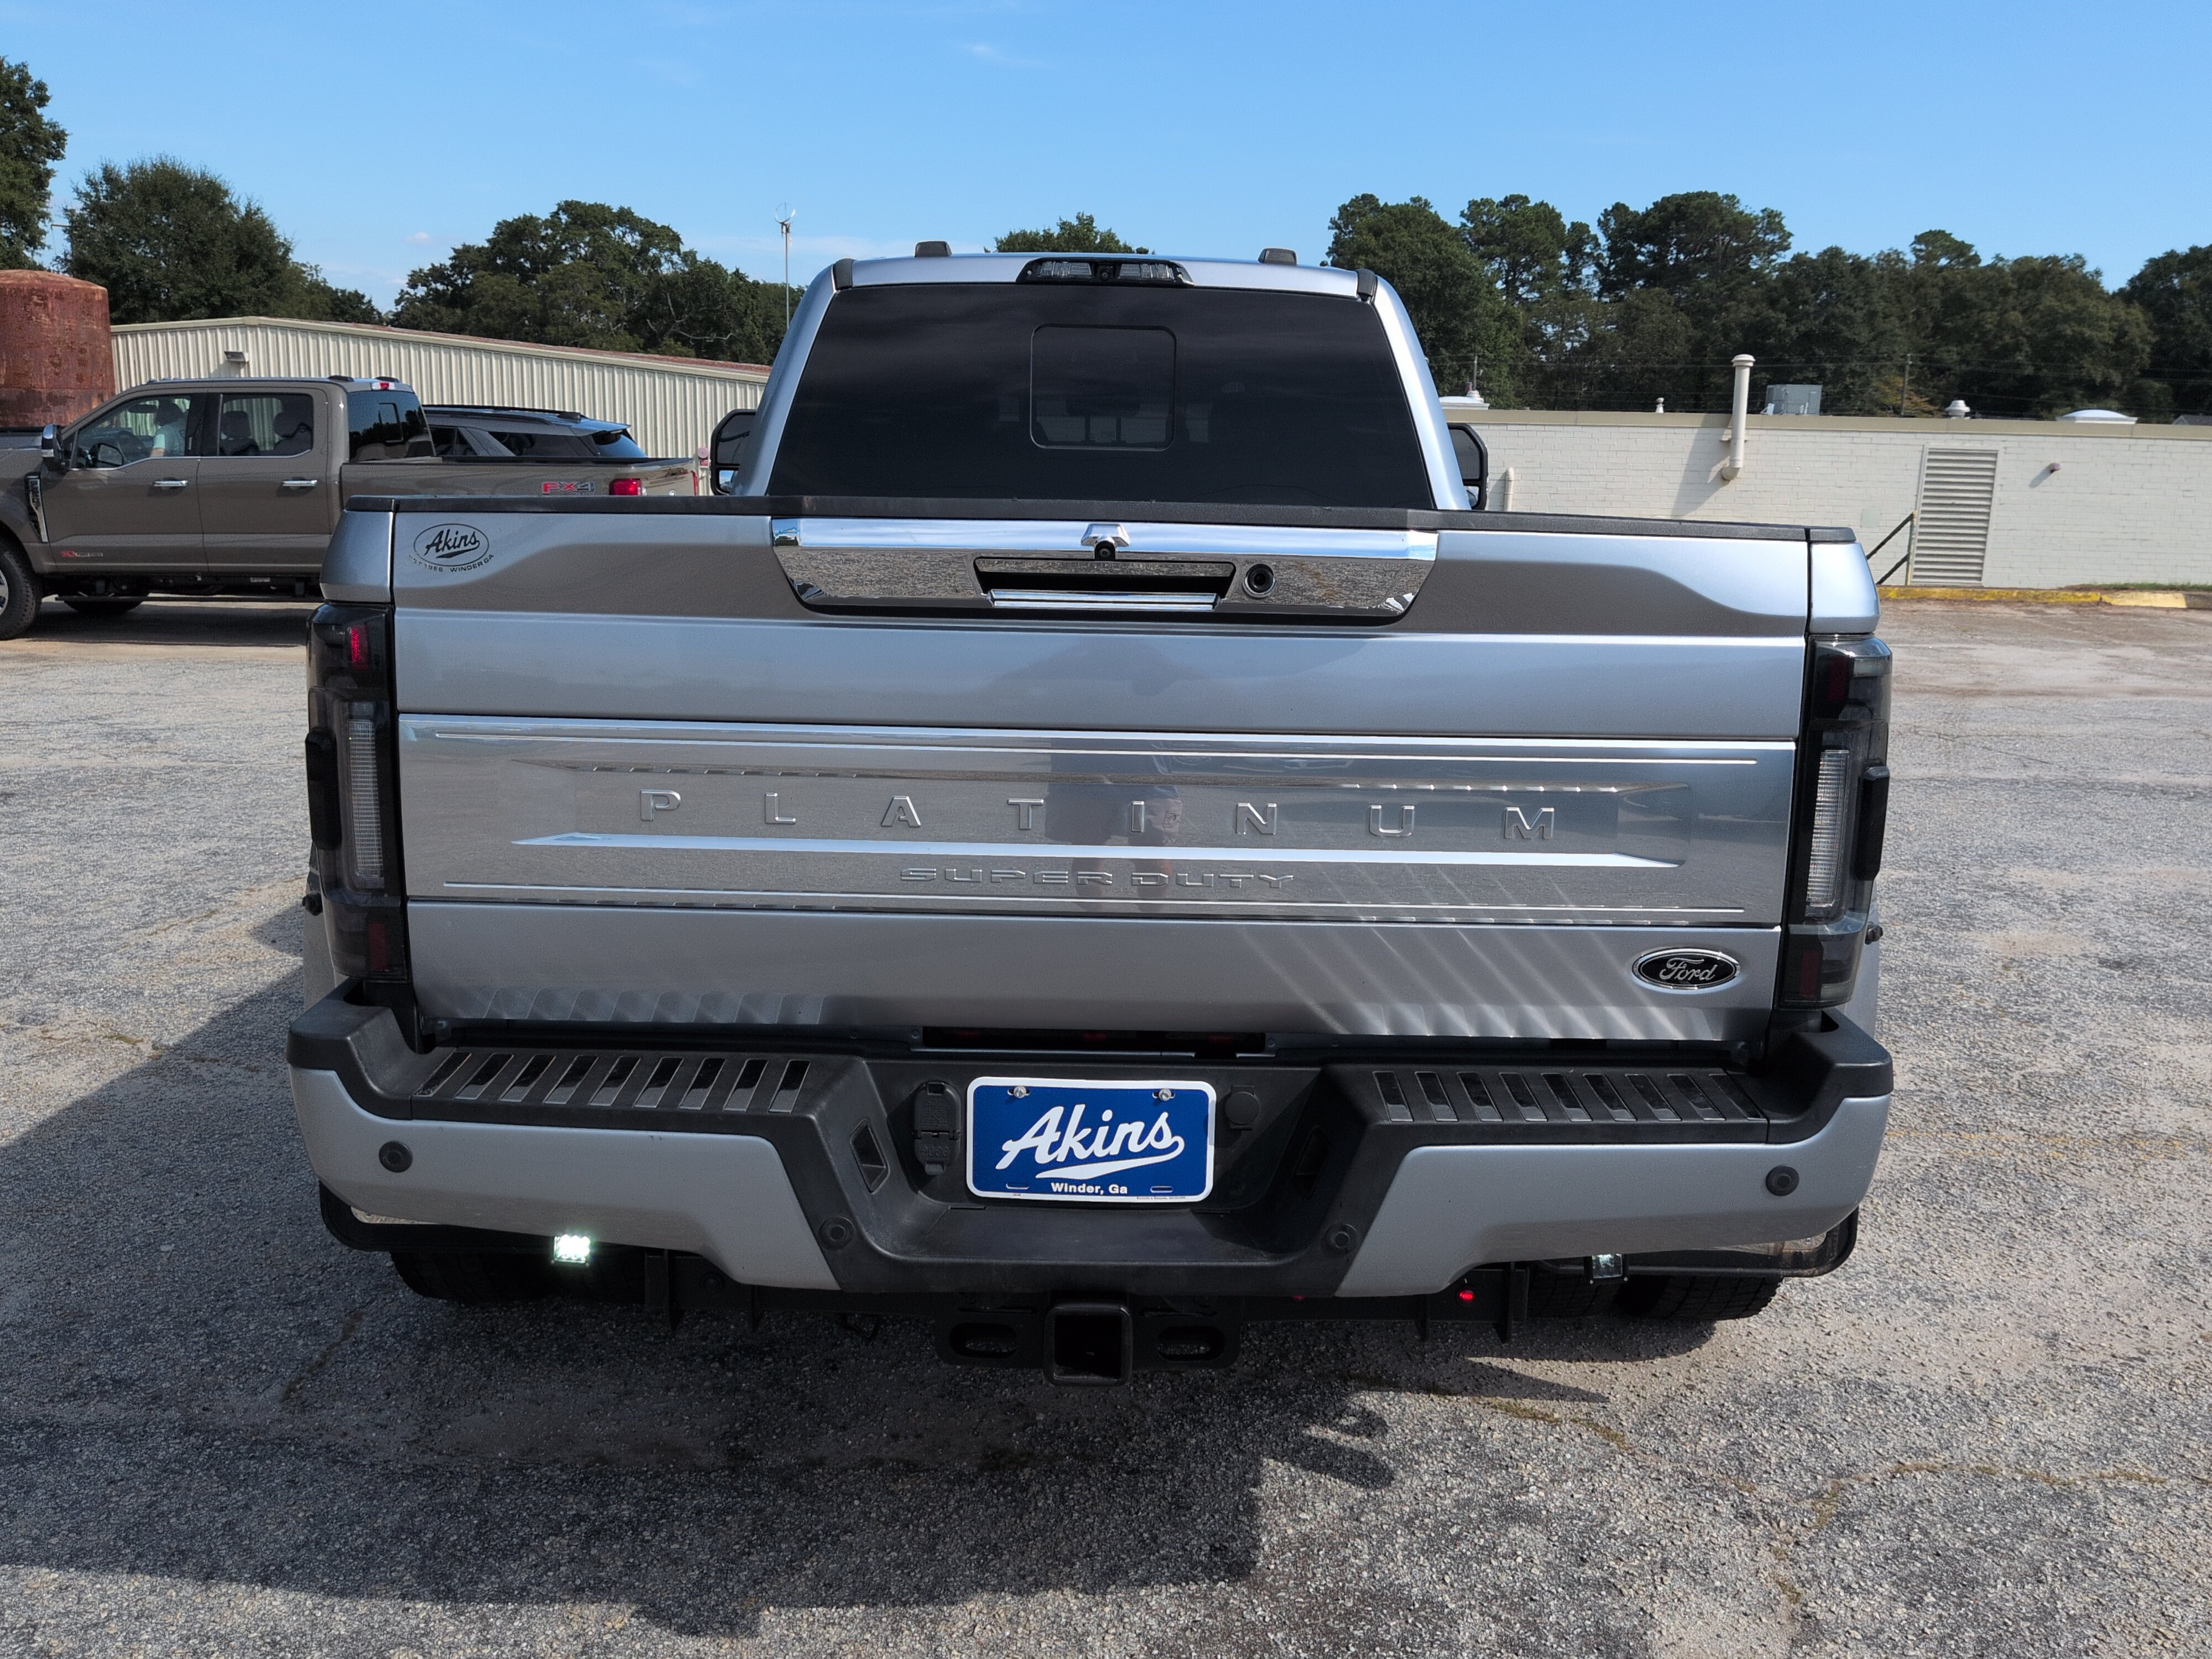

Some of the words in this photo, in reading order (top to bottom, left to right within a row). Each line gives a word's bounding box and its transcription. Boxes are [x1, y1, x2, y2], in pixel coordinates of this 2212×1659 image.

[542, 482, 595, 494] FX4
[424, 529, 480, 556] Akins
[450, 561, 483, 572] WINDER
[484, 555, 494, 564] GA
[640, 789, 1555, 839] PLATINUM
[901, 868, 1113, 885] SUPER
[1132, 872, 1293, 888] DUTY
[1659, 957, 1718, 981] Ford
[996, 1104, 1185, 1171] Akins
[1051, 1182, 1104, 1194] Winder,
[1108, 1184, 1128, 1194] Ga
